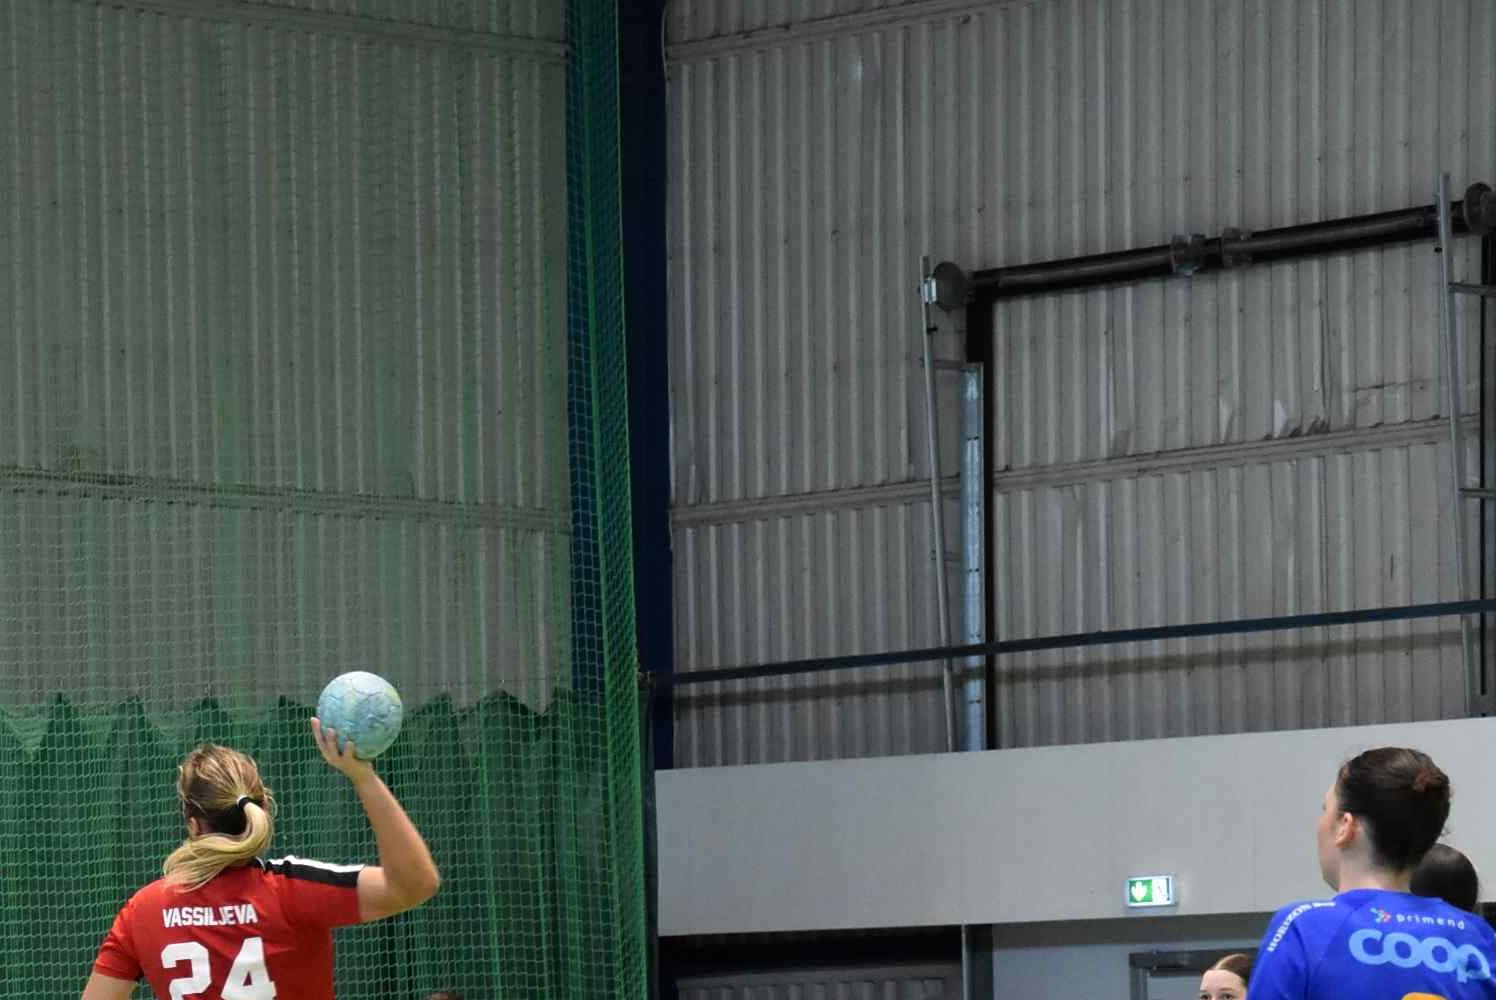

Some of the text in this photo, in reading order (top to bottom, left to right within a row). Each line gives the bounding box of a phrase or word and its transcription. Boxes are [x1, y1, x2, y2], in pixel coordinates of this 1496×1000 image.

[162, 903, 259, 929] VASSILJEVA
[1395, 913, 1466, 930] primend
[1348, 928, 1491, 984] coop
